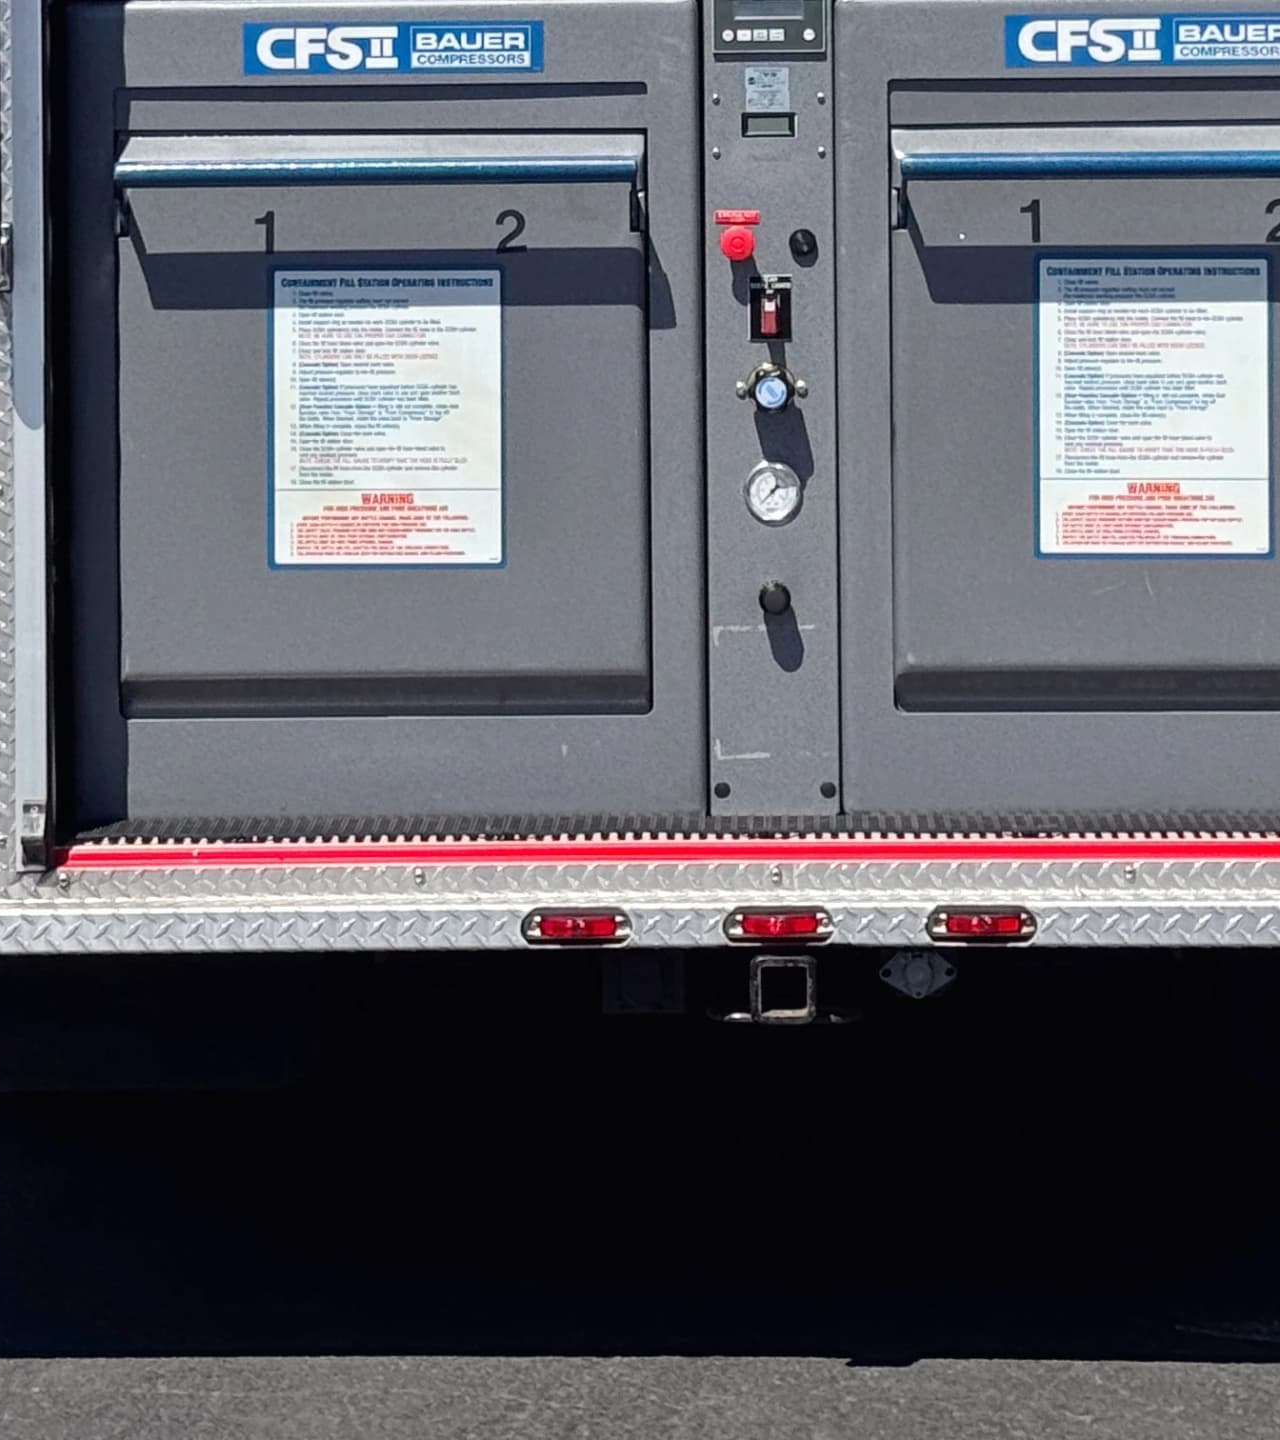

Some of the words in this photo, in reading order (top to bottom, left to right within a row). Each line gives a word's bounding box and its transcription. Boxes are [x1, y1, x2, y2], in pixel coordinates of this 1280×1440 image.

[415, 32, 526, 51] BAUER
[417, 53, 526, 66] COMPRESSORS
[1020, 198, 1041, 244] 1
[254, 210, 276, 255] 1
[495, 209, 528, 254] 2
[1105, 266, 1121, 276] FILL
[1123, 266, 1156, 276] STATION
[1157, 266, 1201, 276] OPERATING
[1203, 266, 1261, 276] INSTRUCTIONS
[339, 277, 356, 287] FILL
[357, 277, 390, 287] STATION
[391, 277, 435, 287] OPERATING
[437, 277, 494, 287] INSTRUCTIONS
[1127, 482, 1181, 494] WARNING
[361, 493, 414, 505] WARNING
